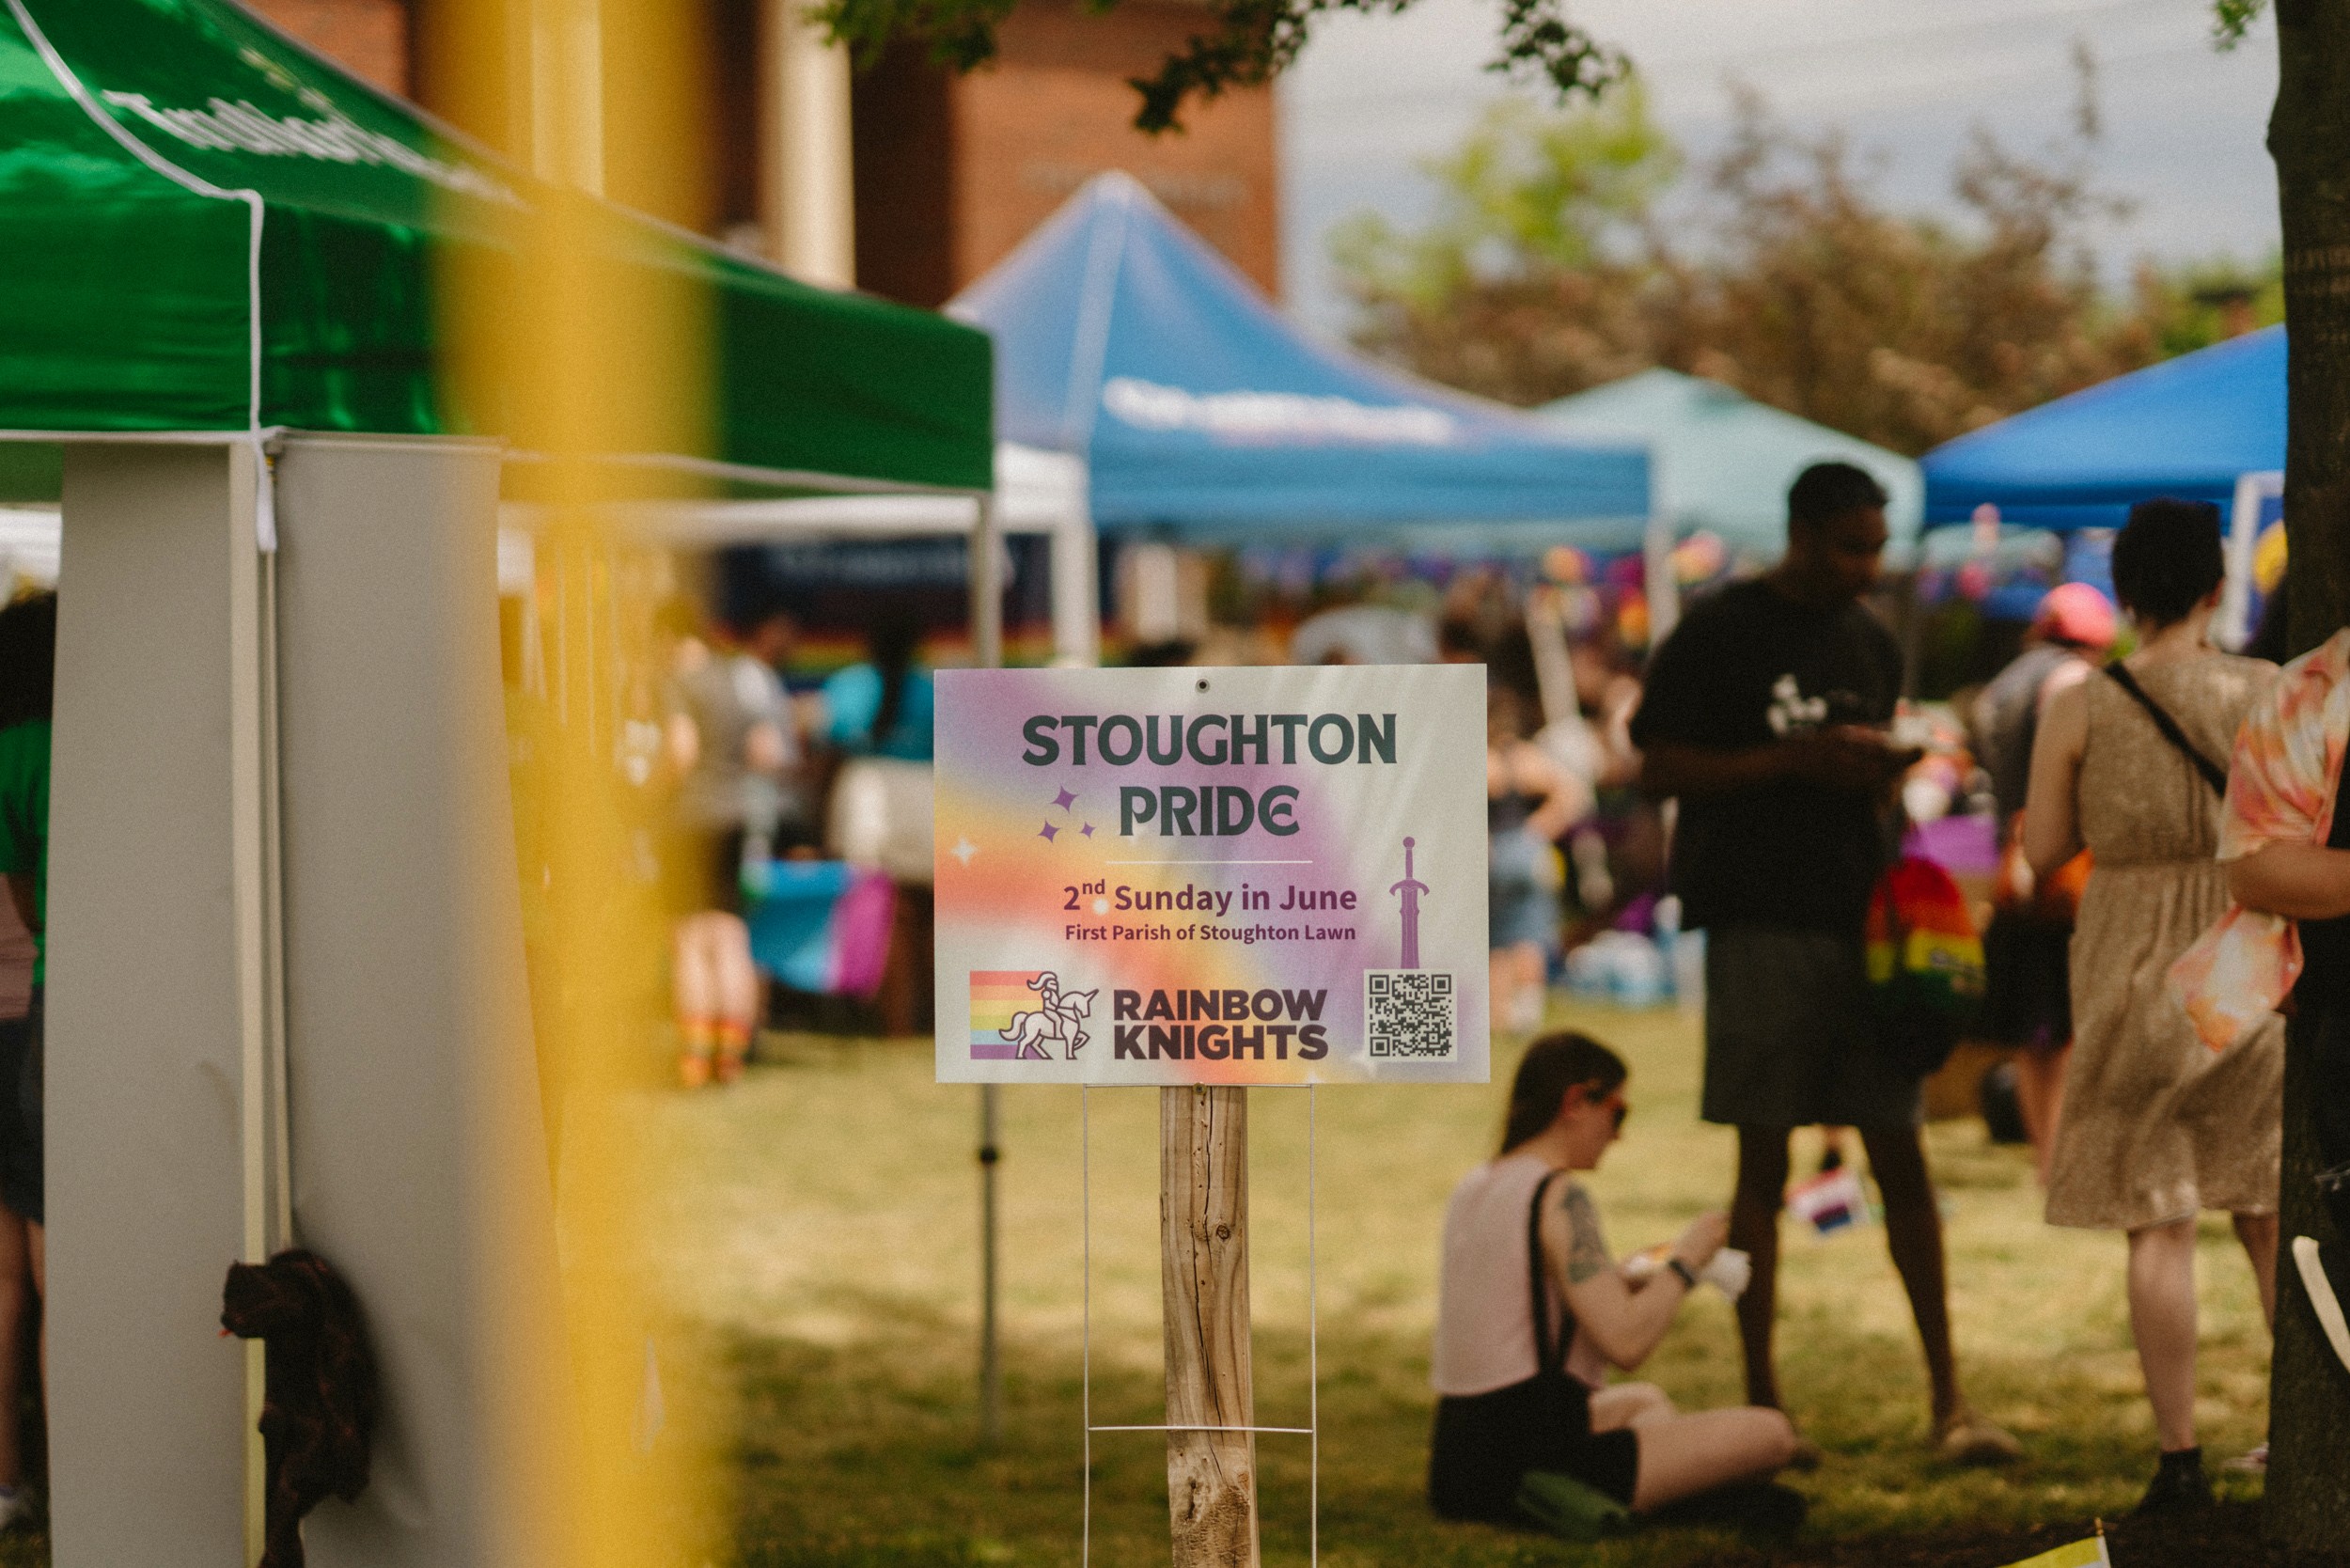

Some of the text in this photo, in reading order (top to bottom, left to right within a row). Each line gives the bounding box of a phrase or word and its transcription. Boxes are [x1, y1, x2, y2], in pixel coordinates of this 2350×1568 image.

[1022, 713, 1397, 765] STOUGHTON
[1119, 785, 1300, 837] PRIDE
[1063, 879, 1357, 917] 2nd Sunday in June
[1065, 923, 1356, 945] First Parish of Stoughton Lawn
[1114, 989, 1327, 1021] RAINBOW
[1114, 1025, 1328, 1060] KNIGHTS
